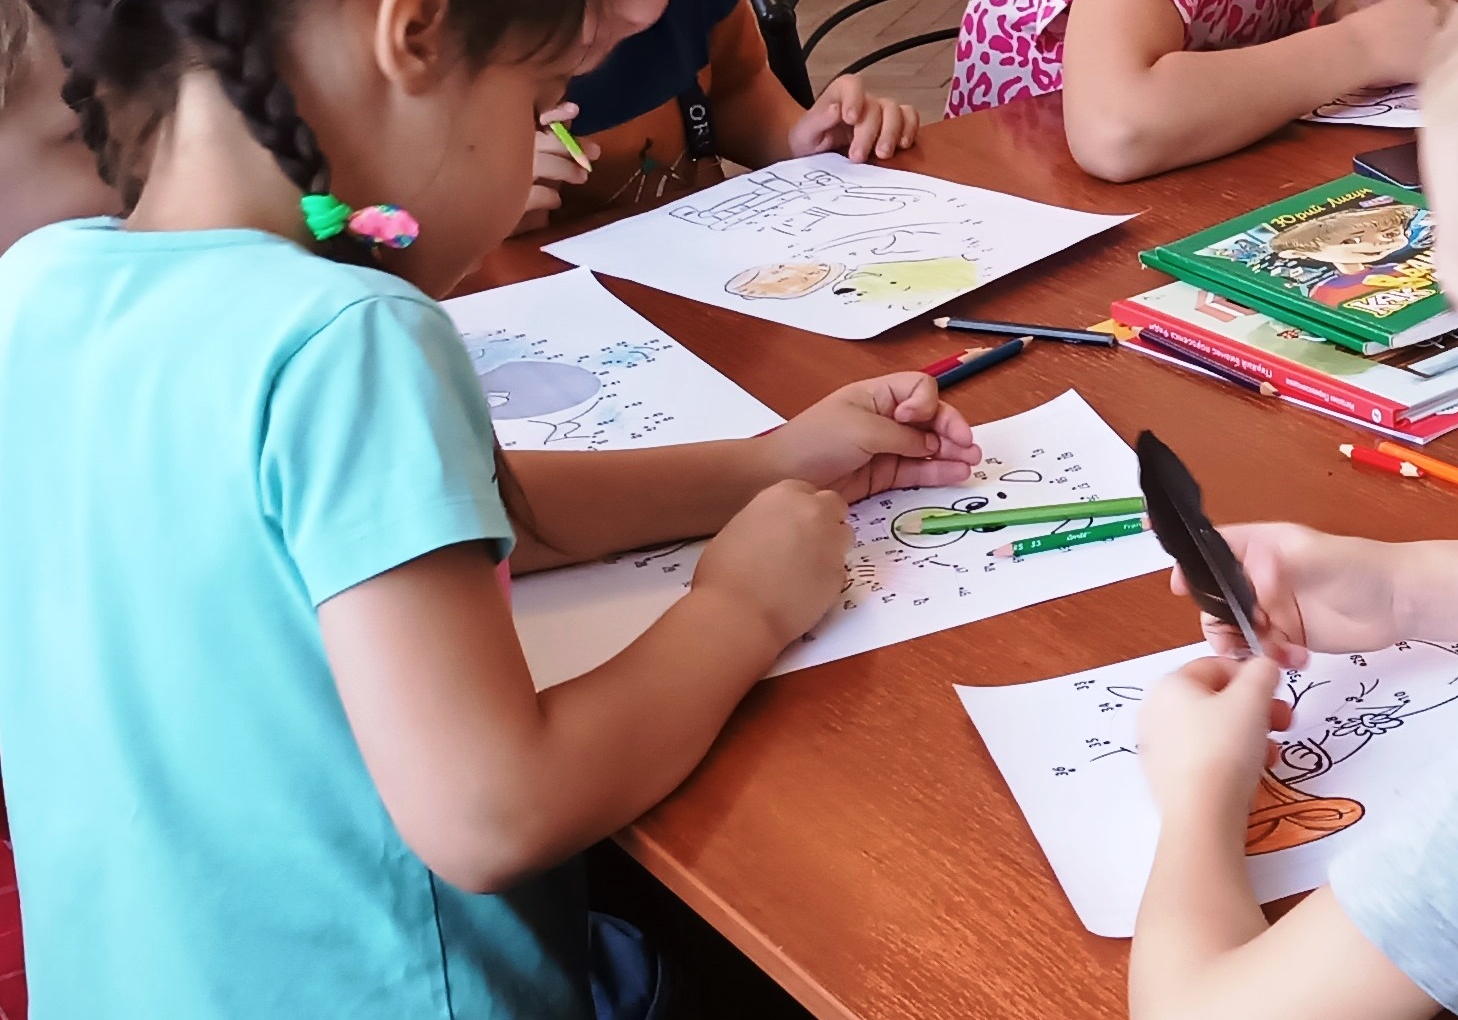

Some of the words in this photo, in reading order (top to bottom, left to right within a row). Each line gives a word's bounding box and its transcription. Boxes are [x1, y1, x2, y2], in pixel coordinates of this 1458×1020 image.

[1271, 204, 1326, 228] Юрий
[1344, 288, 1436, 318] КАК
[1085, 738, 1102, 748] 35
[1052, 766, 1069, 776] 36
